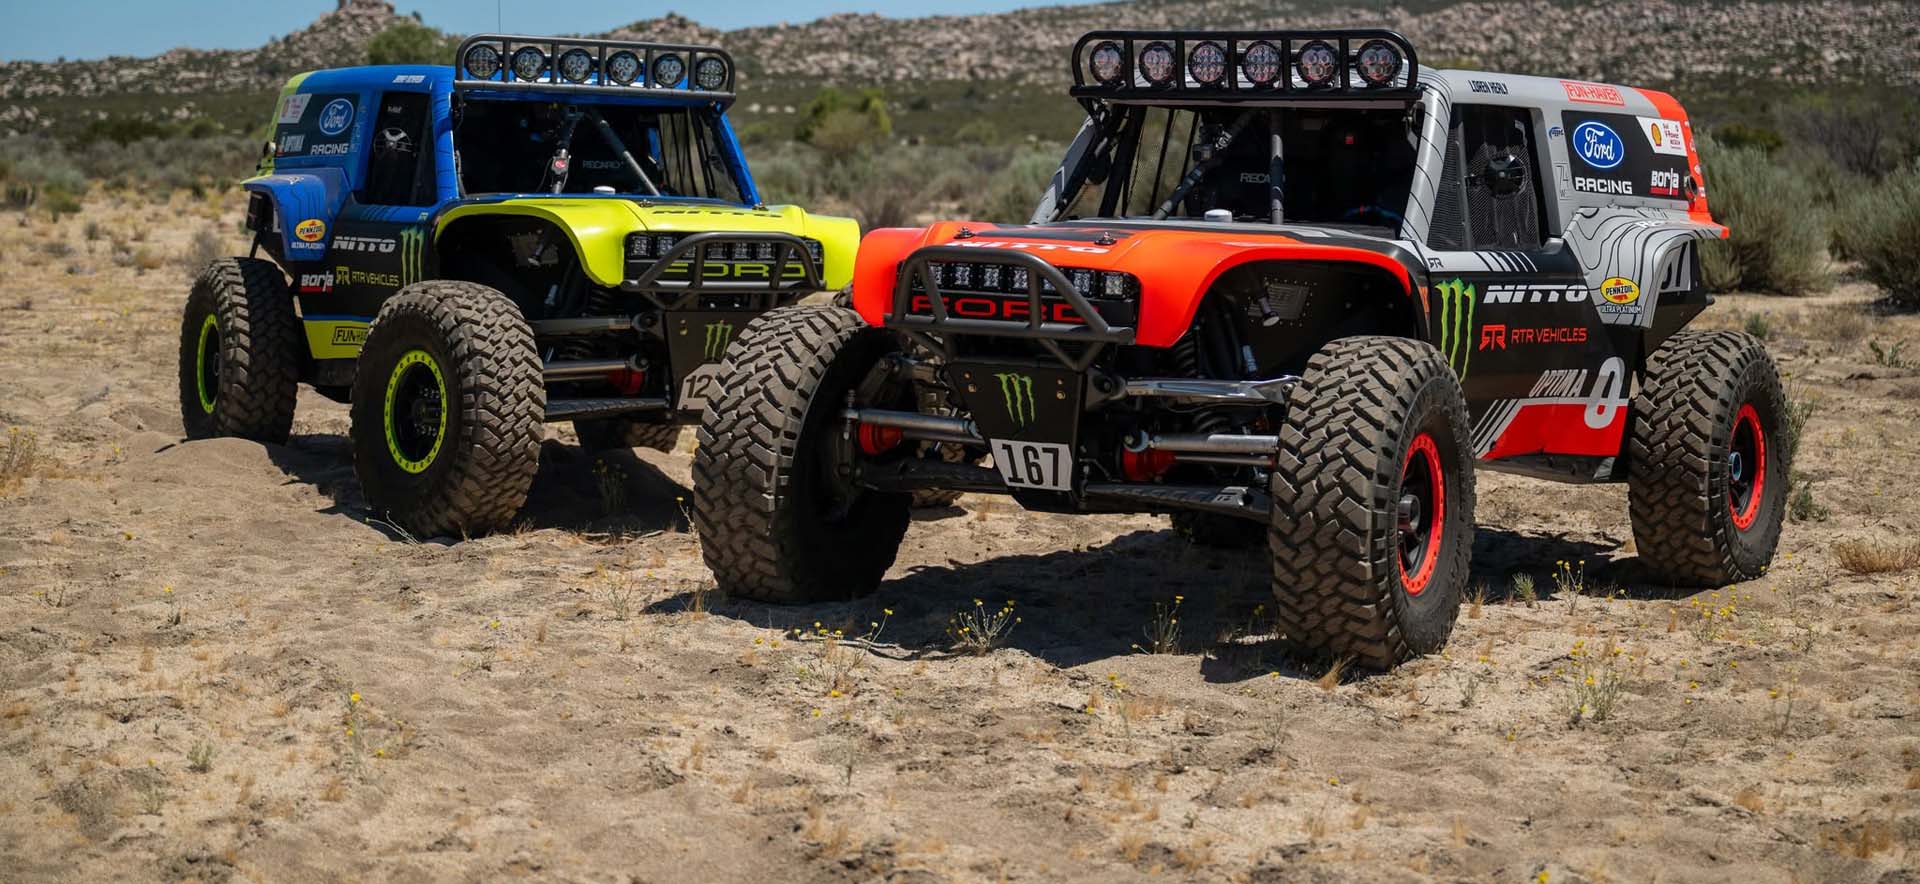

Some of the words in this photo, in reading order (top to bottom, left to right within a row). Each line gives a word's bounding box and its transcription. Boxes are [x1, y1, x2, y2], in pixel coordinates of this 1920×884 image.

[1468, 80, 1491, 93] LOREN
[1564, 83, 1621, 102] FUN-HAVER
[323, 103, 349, 129] Ford
[310, 143, 349, 155] RACING
[1584, 127, 1616, 161] Ford
[1575, 177, 1633, 195] RACING
[332, 236, 396, 253] NITTO
[366, 272, 399, 287] VEHICLES
[1483, 285, 1589, 304] NITTO
[1605, 285, 1633, 296] PENNZOIL
[911, 295, 1099, 322] FORD
[1601, 305, 1616, 313] ULTRA
[1616, 306, 1641, 314] PLATINUM
[1510, 328, 1535, 344] RTR
[1537, 328, 1588, 343] VEHICLES
[1528, 369, 1588, 398] OPTIMA
[1002, 443, 1060, 487] 167
